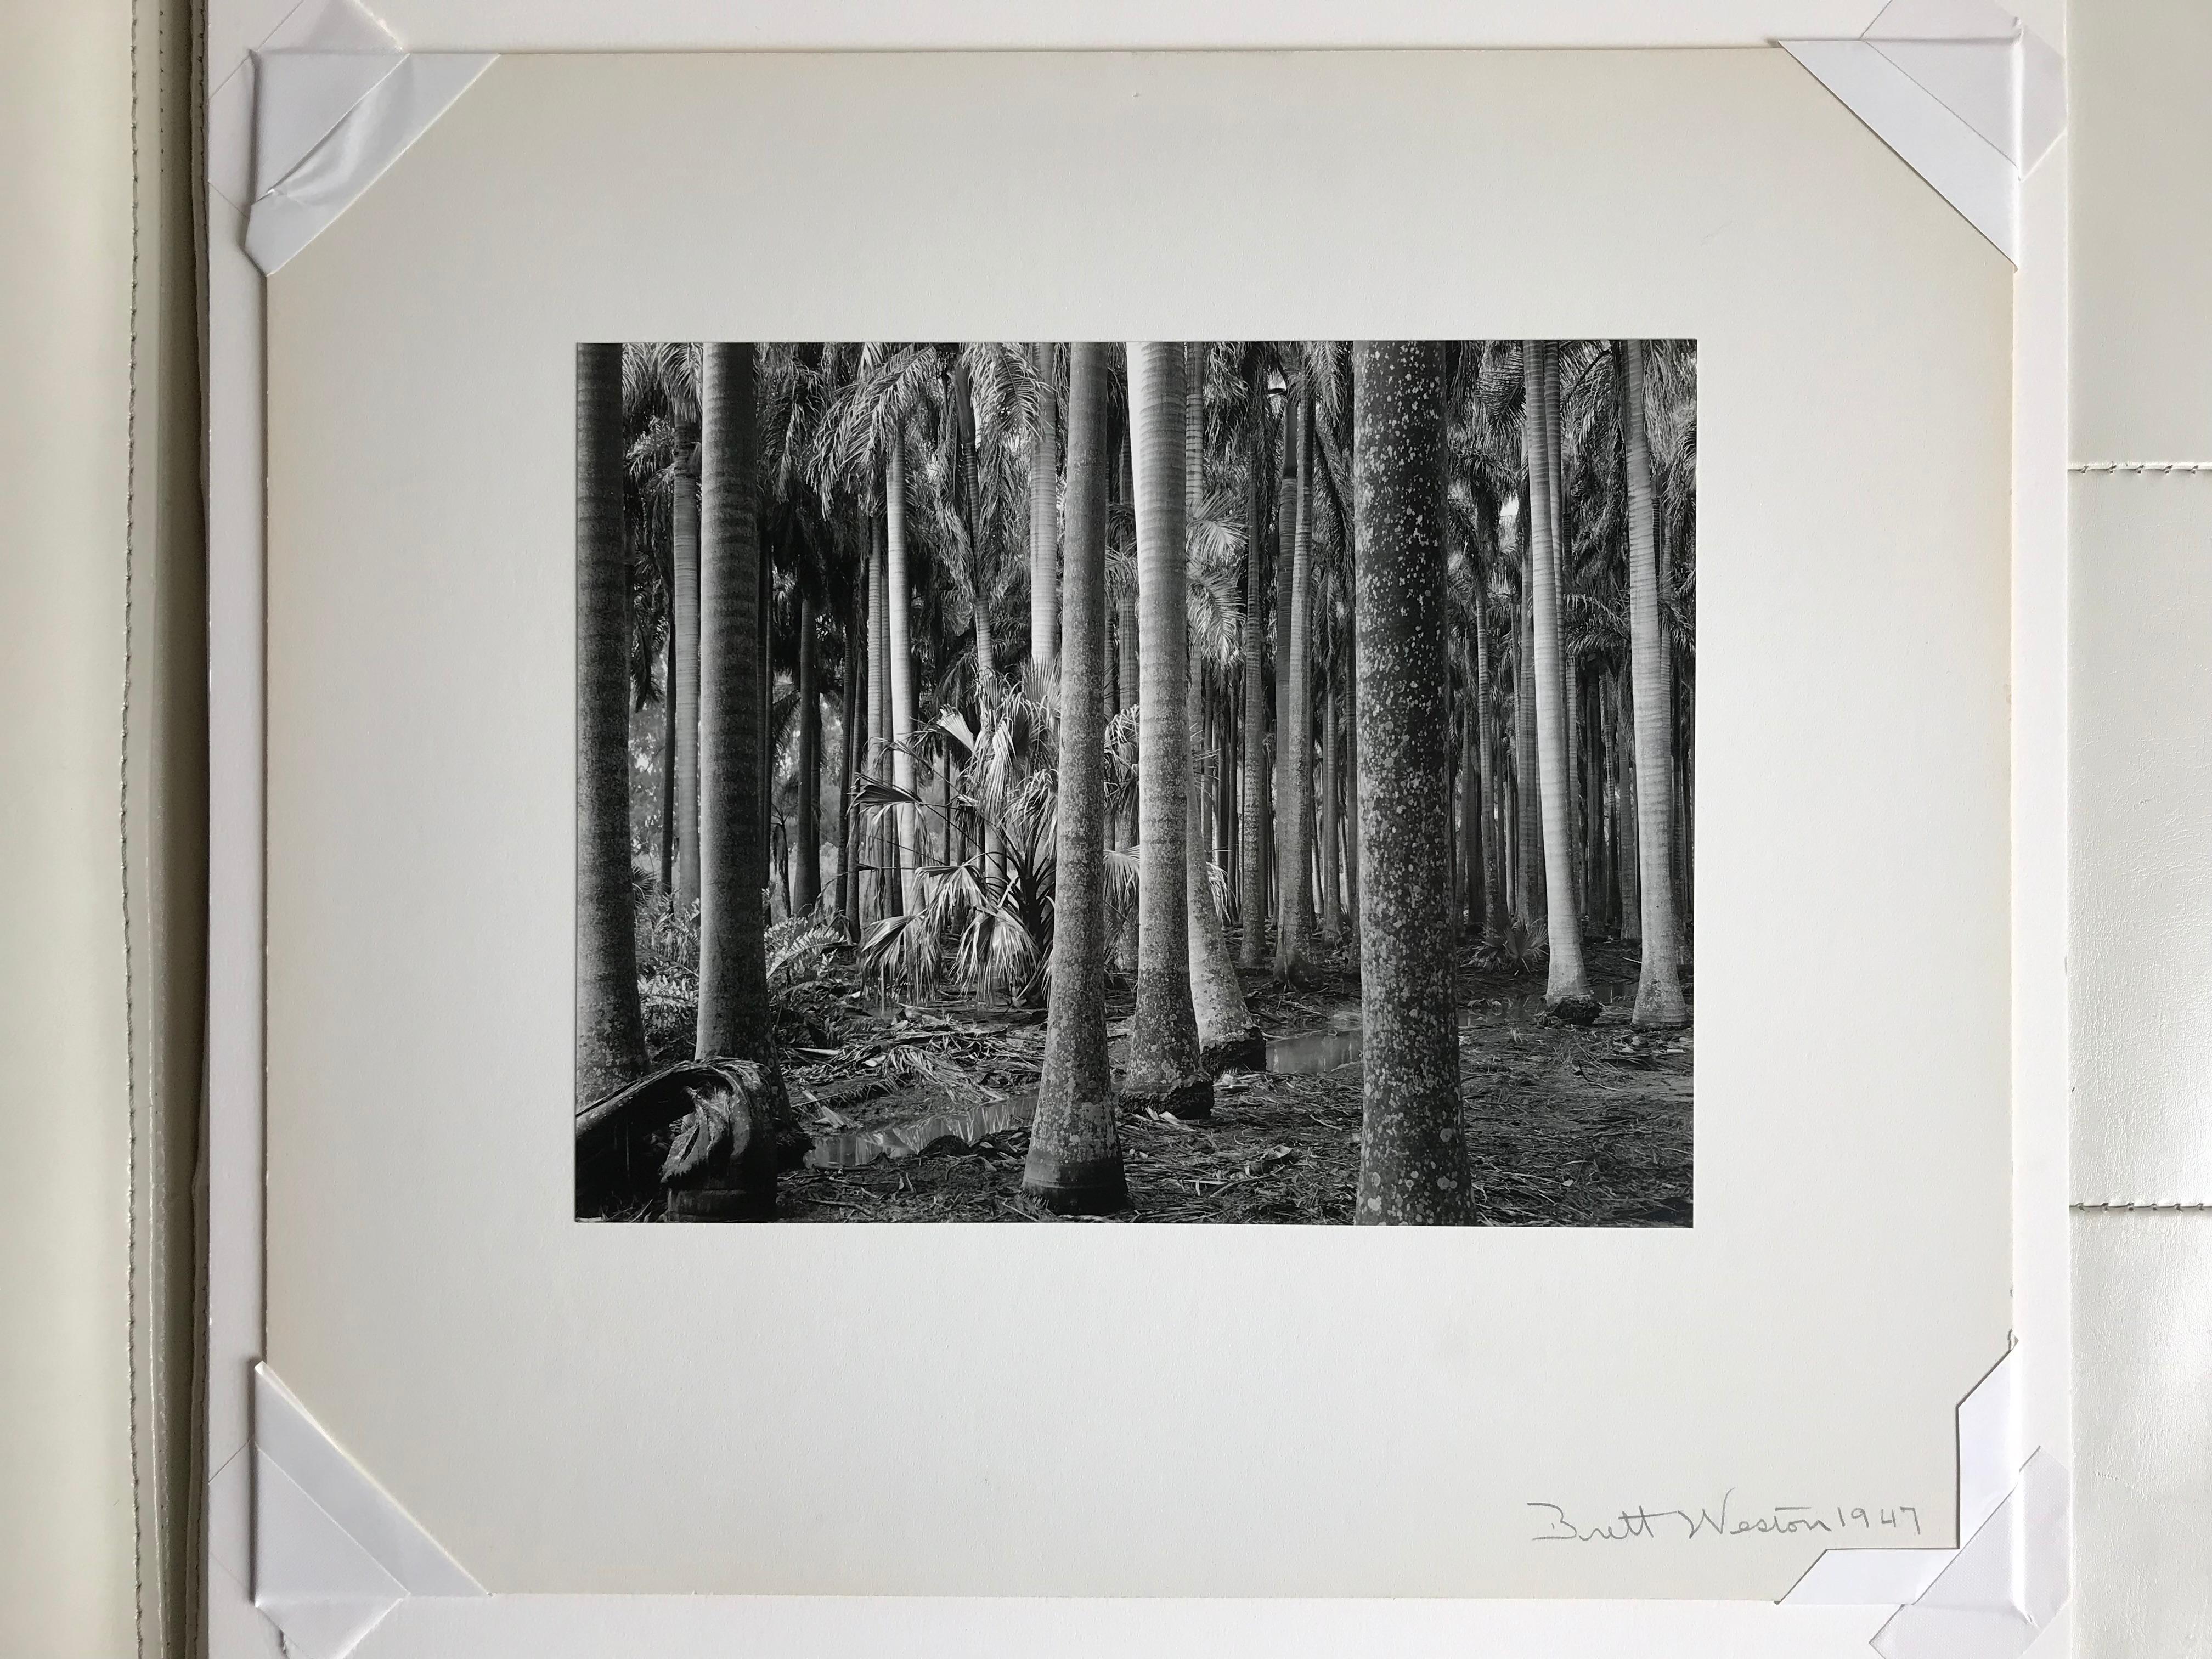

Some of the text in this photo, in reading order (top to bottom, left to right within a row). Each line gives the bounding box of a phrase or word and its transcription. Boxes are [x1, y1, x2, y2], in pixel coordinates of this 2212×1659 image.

[1527, 1487, 1920, 1541] Brett Weston 1947
